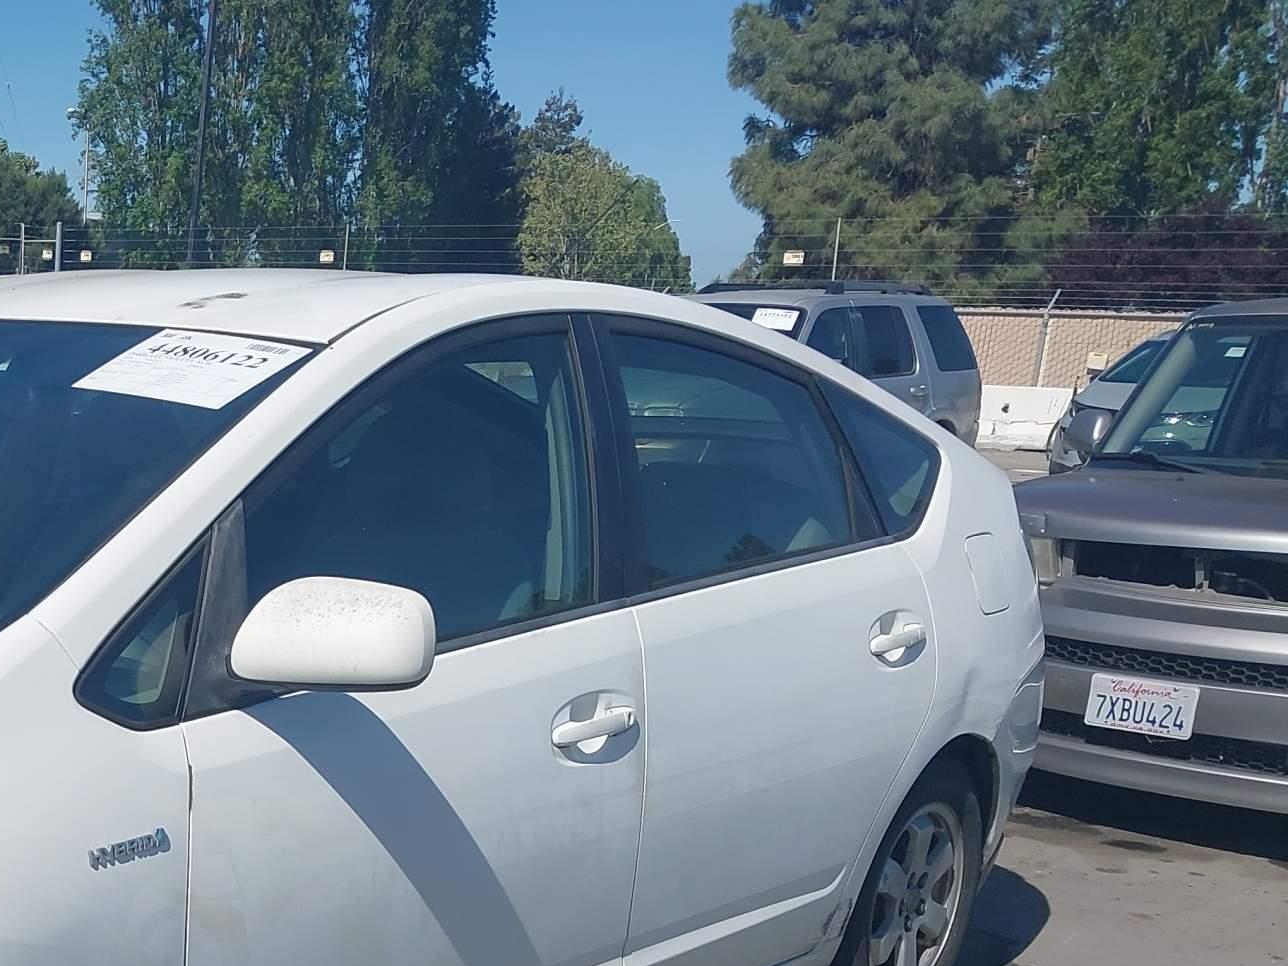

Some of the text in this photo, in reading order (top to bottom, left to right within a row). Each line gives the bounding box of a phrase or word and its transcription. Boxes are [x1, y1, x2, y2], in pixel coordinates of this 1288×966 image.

[148, 343, 269, 369] 44806122
[1112, 680, 1174, 699] California
[1095, 693, 1184, 731] 7XBU424
[87, 833, 158, 872] HYBRID
